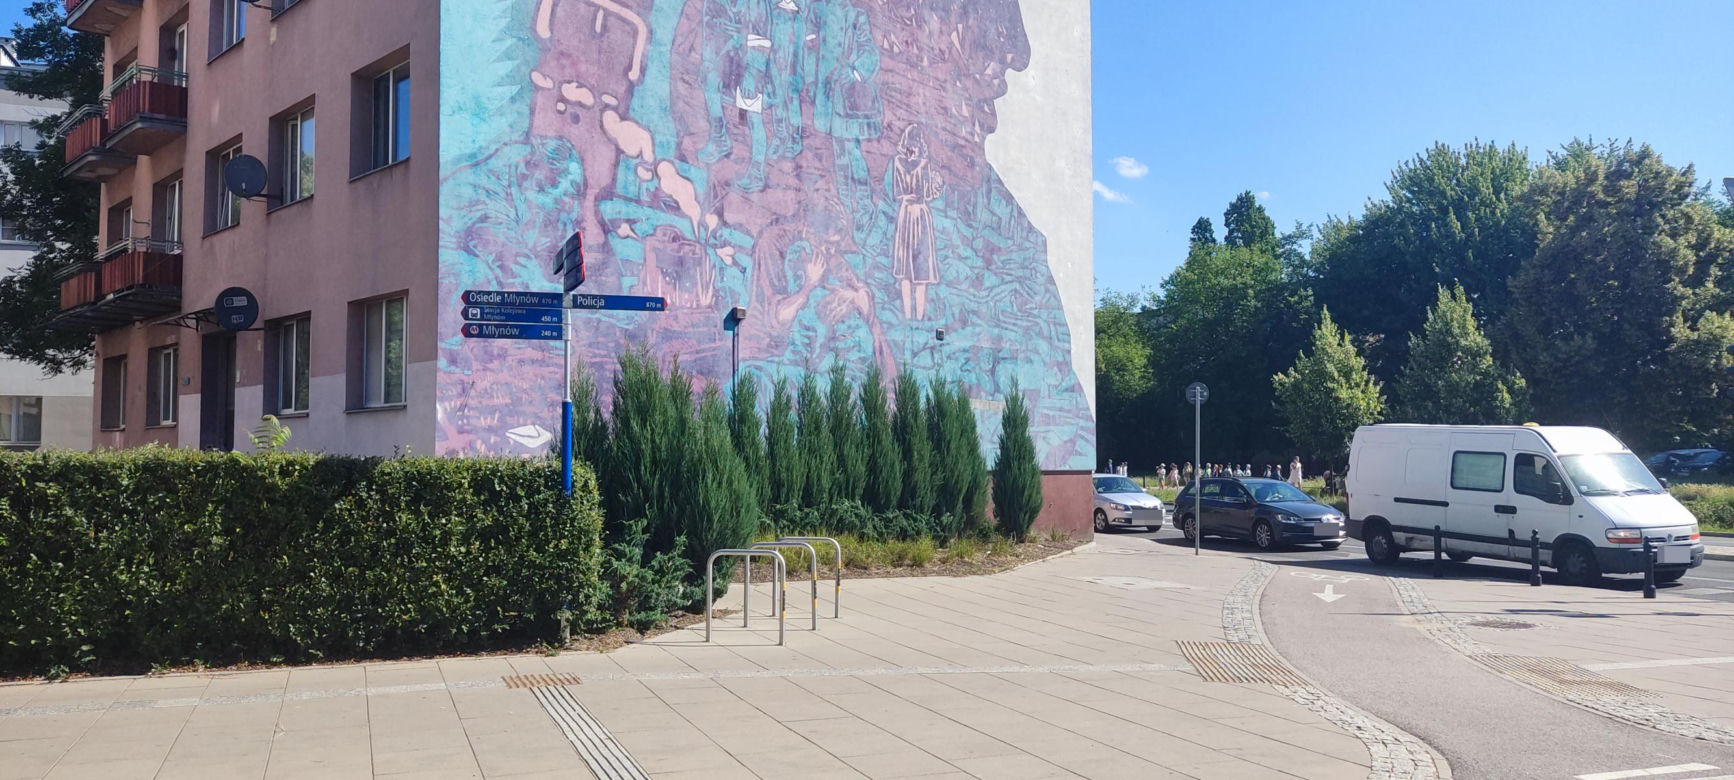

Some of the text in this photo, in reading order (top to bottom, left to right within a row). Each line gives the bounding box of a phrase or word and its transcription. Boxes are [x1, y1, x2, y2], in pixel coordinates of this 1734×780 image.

[469, 292, 502, 303] Osiedle
[504, 293, 539, 306] Młynów
[577, 296, 605, 308] Policja
[482, 326, 520, 339] Młynów
